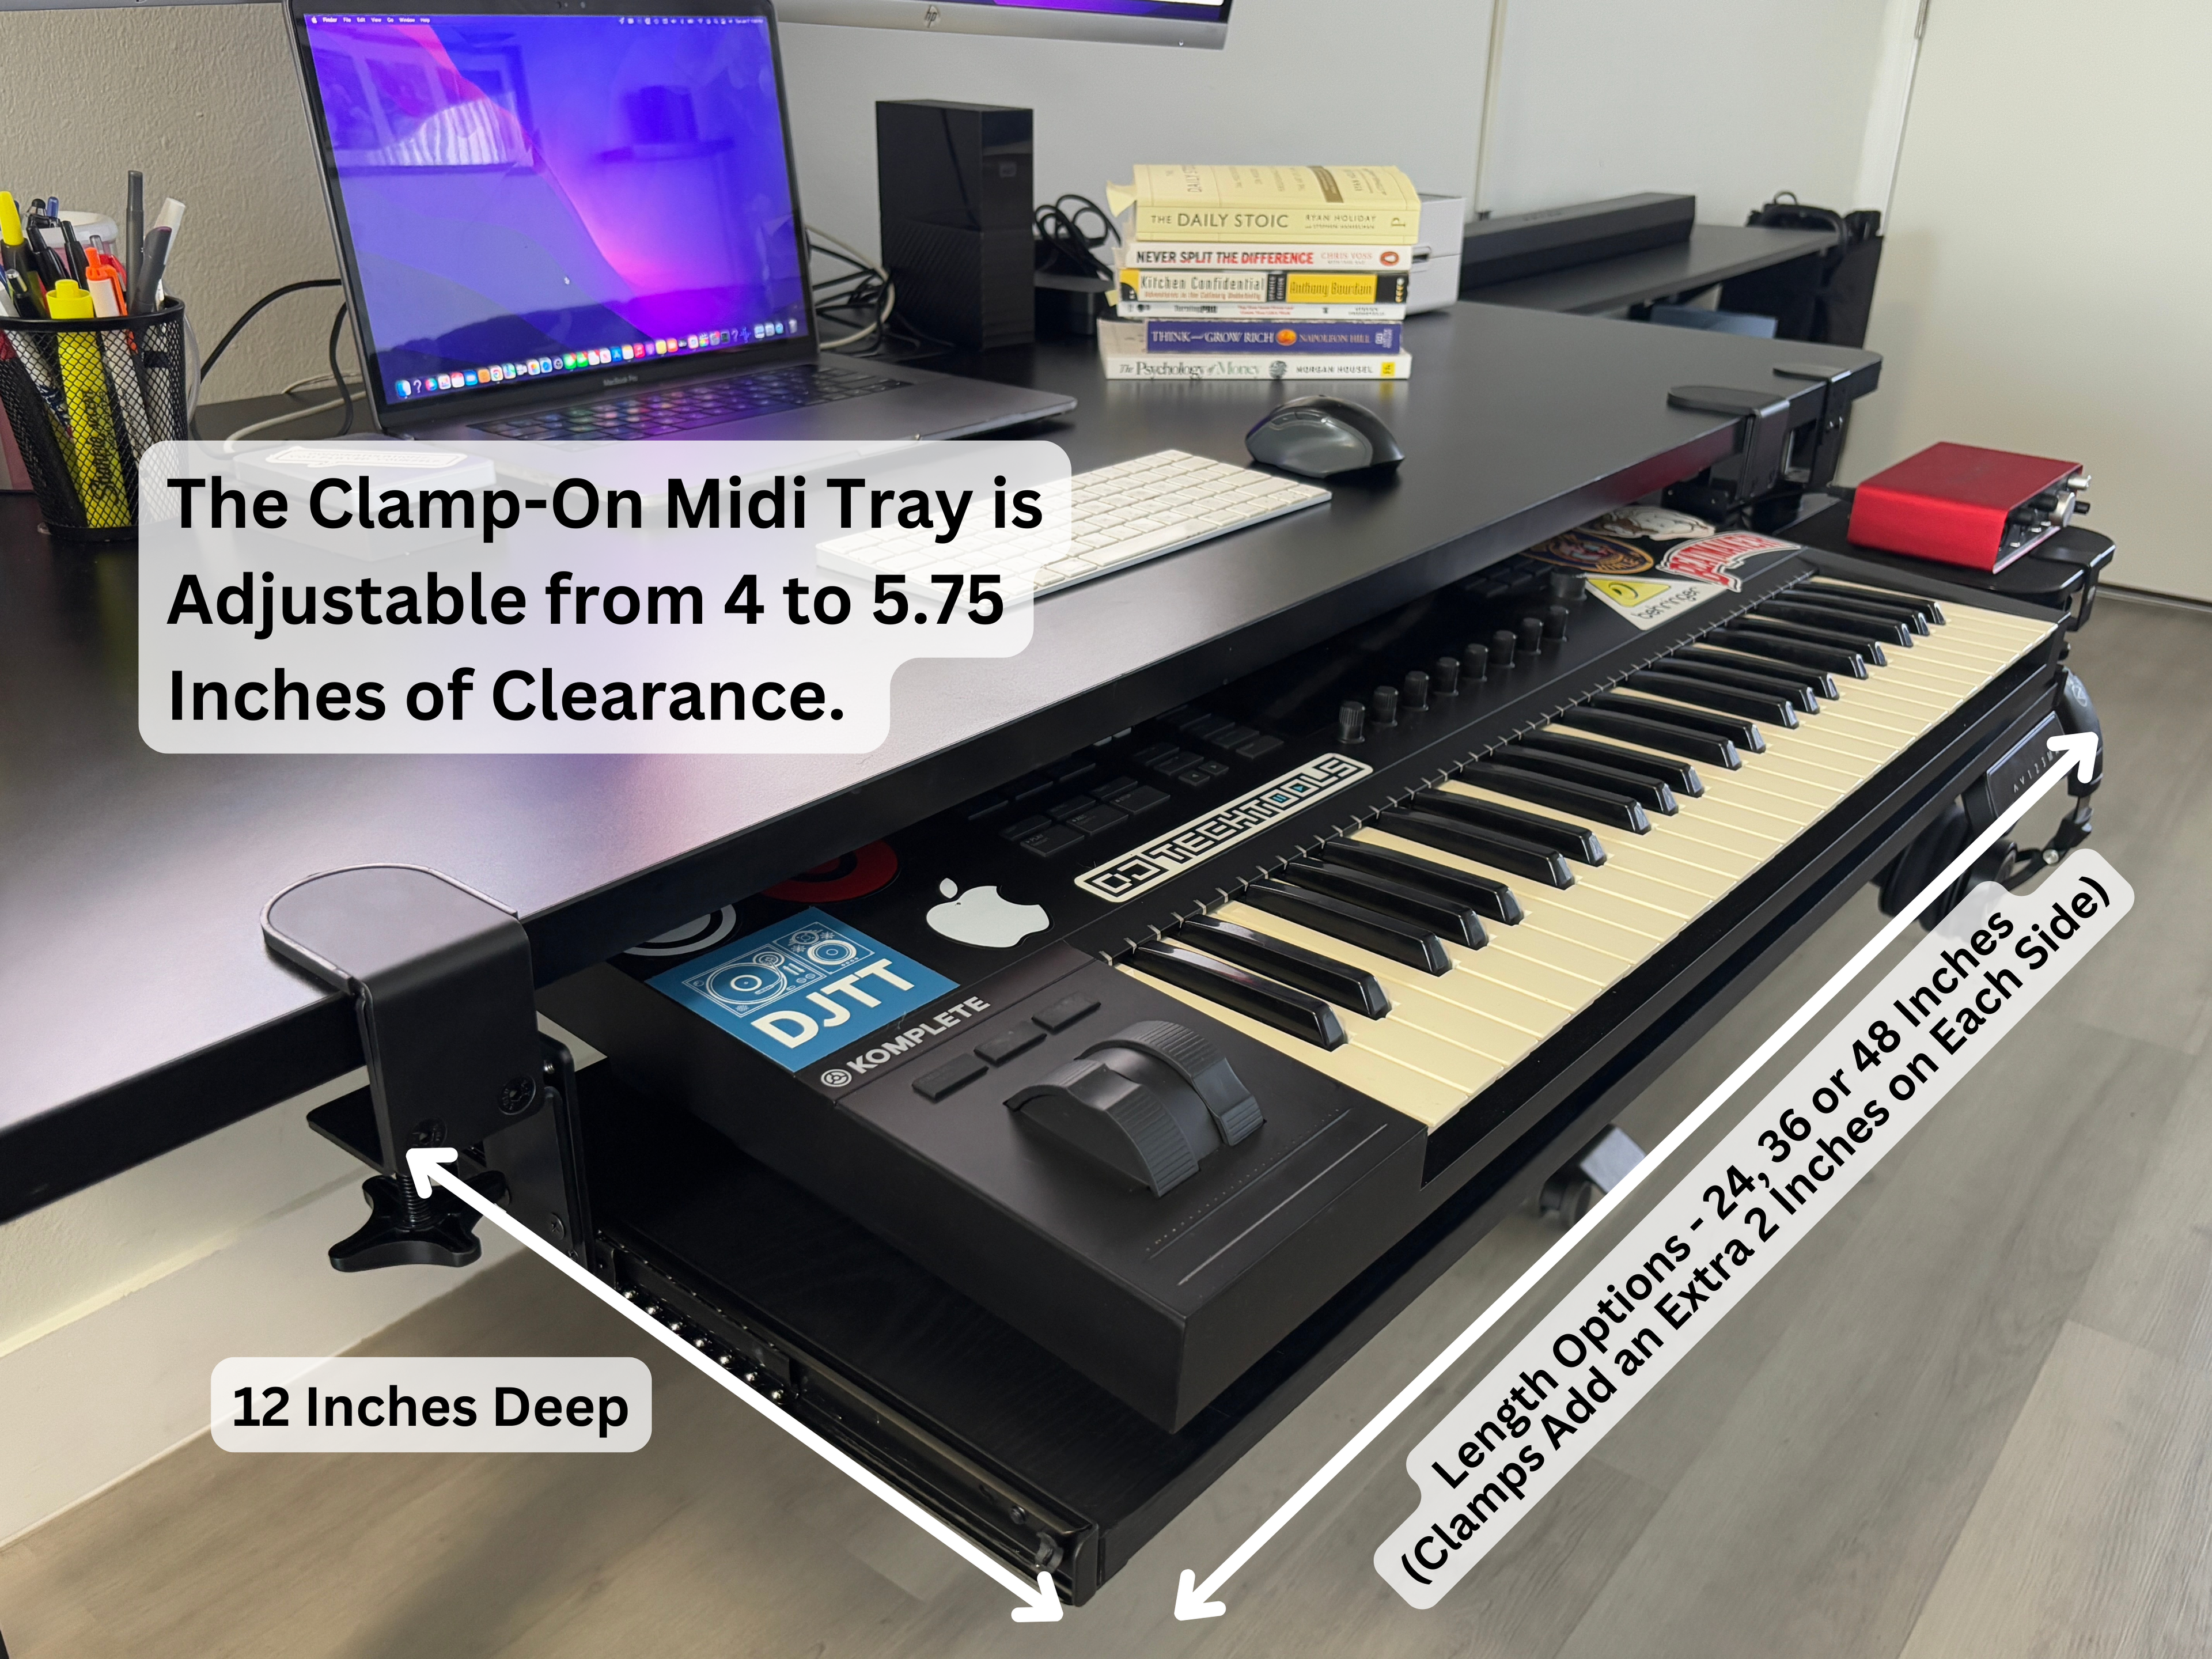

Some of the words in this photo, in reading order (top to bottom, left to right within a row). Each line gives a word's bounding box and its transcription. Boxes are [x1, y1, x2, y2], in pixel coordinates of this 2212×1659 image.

[924, 5, 938, 28] hp
[1151, 215, 1172, 224] THE
[1177, 214, 1230, 228] DAILY
[1234, 214, 1289, 228] STOIC
[1137, 251, 1176, 263] NEVER
[1180, 251, 1213, 264] SPLIT
[1216, 252, 1238, 264] THE
[1241, 252, 1314, 264] DIFFERENCE
[1141, 276, 1186, 290] Kitchen
[1191, 276, 1265, 291] Confidential
[1290, 281, 1330, 297] Anthony
[1331, 282, 1372, 296] Bourdain
[1151, 331, 1191, 342] THINK
[1205, 332, 1241, 343] GROW
[1244, 332, 1274, 343] RICH
[1299, 334, 1348, 343] NAPOLEON
[1350, 334, 1370, 344] HILL
[1119, 364, 1134, 373] The
[1136, 361, 1205, 380] Psychology
[1216, 361, 1262, 378] Money
[1631, 585, 1700, 620] behringer
[1149, 759, 1359, 861] TECHTOOLS
[751, 959, 915, 1048] DJTT
[847, 996, 991, 1073] KOMPLETE
